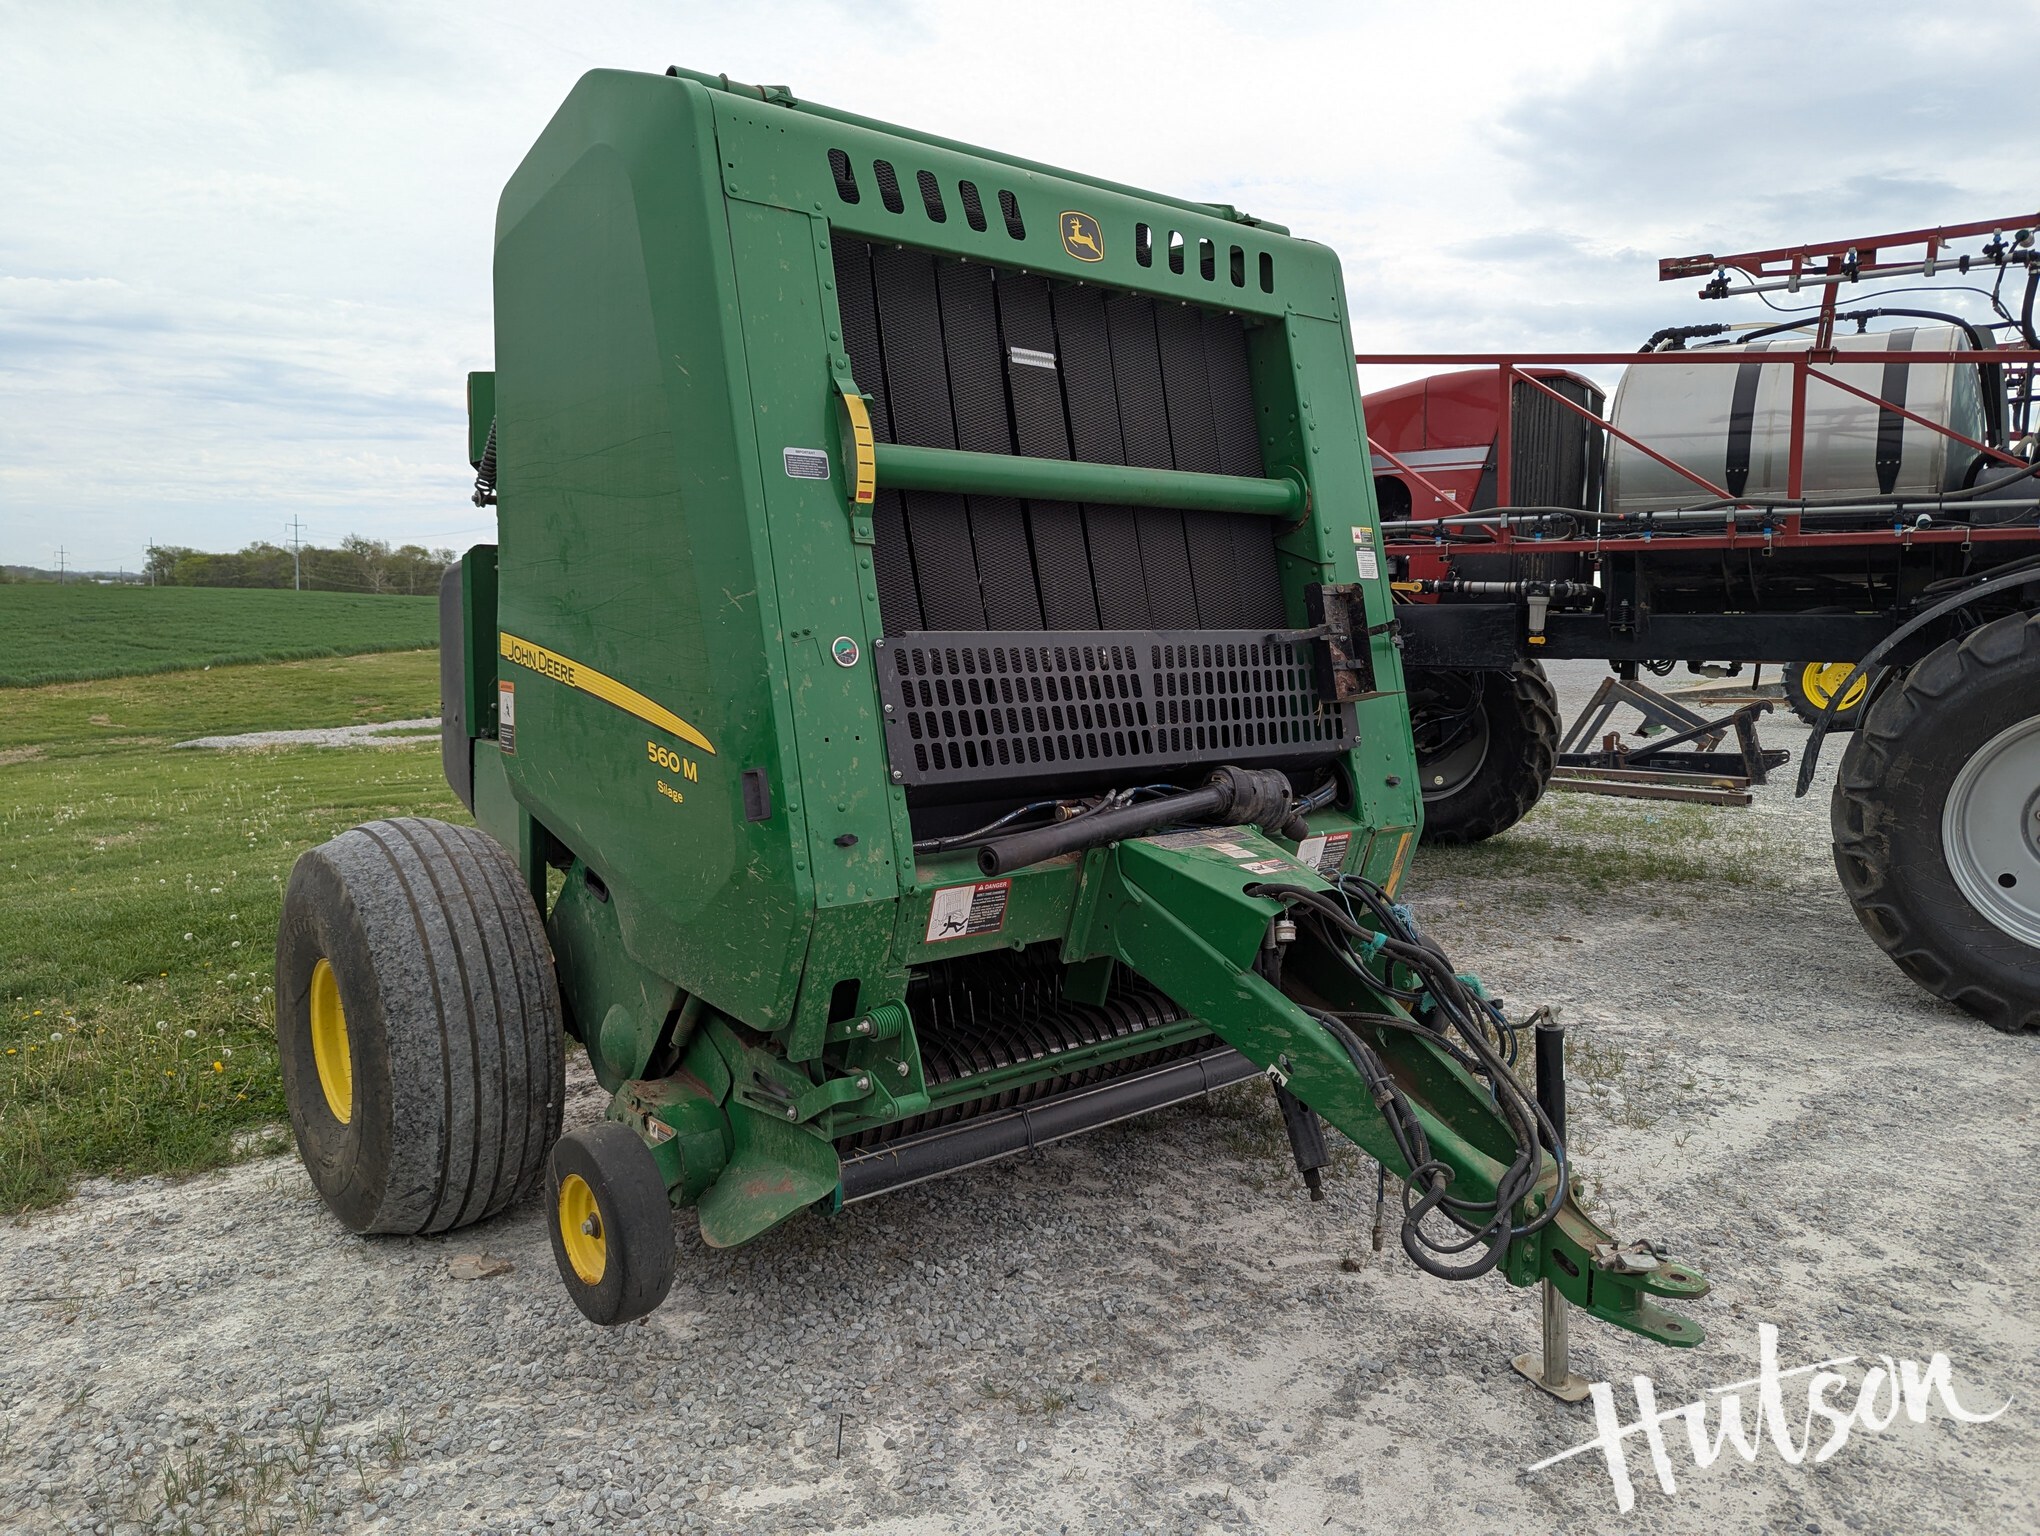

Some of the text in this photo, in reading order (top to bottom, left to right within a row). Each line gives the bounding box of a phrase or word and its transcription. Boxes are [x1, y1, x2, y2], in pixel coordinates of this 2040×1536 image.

[508, 640, 575, 684] JOHN DEERE
[648, 741, 698, 783] 560 M
[657, 780, 684, 804] Silage
[984, 881, 1007, 890] DANGER
